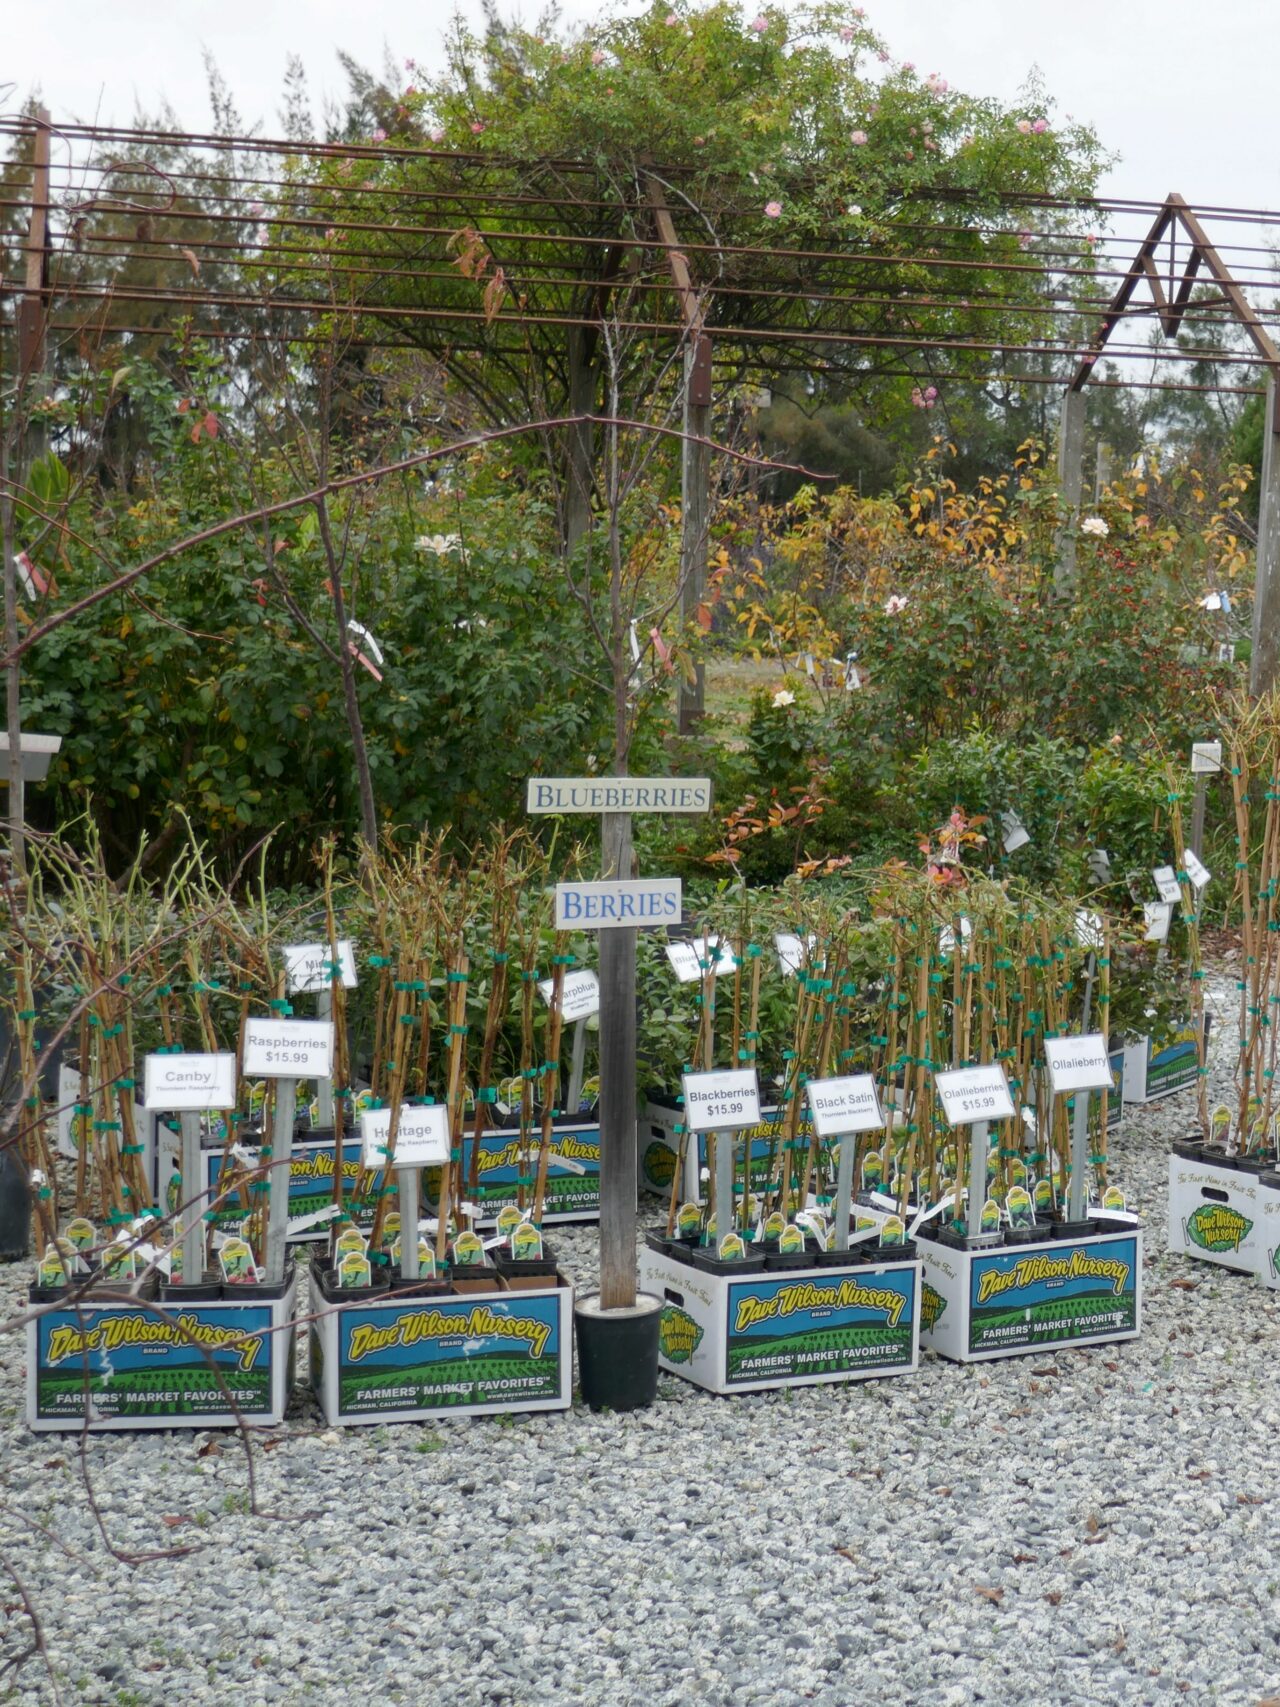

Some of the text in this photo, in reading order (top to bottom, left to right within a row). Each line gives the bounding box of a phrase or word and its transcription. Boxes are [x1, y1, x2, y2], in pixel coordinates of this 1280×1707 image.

[535, 785, 706, 808] BLUEBERRIES
[562, 892, 677, 920] BERRIES
[563, 982, 596, 999] arpblue
[249, 1035, 327, 1050] Raspberries
[265, 1051, 308, 1064] $15.99
[1052, 1057, 1107, 1070] Ollalieberry
[165, 1071, 212, 1084] Canby
[689, 1088, 756, 1102] Blackberries
[944, 1083, 1004, 1099] Olallieberries
[815, 1092, 874, 1109] Black Satin
[962, 1097, 995, 1110] $15.99
[707, 1103, 743, 1116] $15.99
[374, 1126, 432, 1138] Heitage
[559, 1136, 600, 1163] Nurse
[1196, 1207, 1246, 1232] Dave Wilson
[1205, 1226, 1240, 1254] Nursery
[977, 1250, 1129, 1305] Dave Wilson Nursery
[735, 1296, 780, 1332] Dave
[778, 1281, 836, 1314] Wilson
[836, 1279, 906, 1328] Nursery
[99, 1315, 173, 1347] Wilson
[348, 1306, 552, 1361] Dave Wilson Nursery
[983, 1325, 1032, 1339] FARMERS'
[1034, 1318, 1072, 1332] MARKET
[999, 1336, 1029, 1346] CALIFORNIA
[741, 1355, 795, 1369] FARMERS'
[797, 1350, 840, 1363] MARKET
[760, 1366, 792, 1377] CALIFORNIA
[126, 1391, 180, 1403] MARKET
[356, 1387, 420, 1401] FARMERS'
[423, 1382, 475, 1395] MARKET
[379, 1399, 417, 1408] CALIFORNIA
